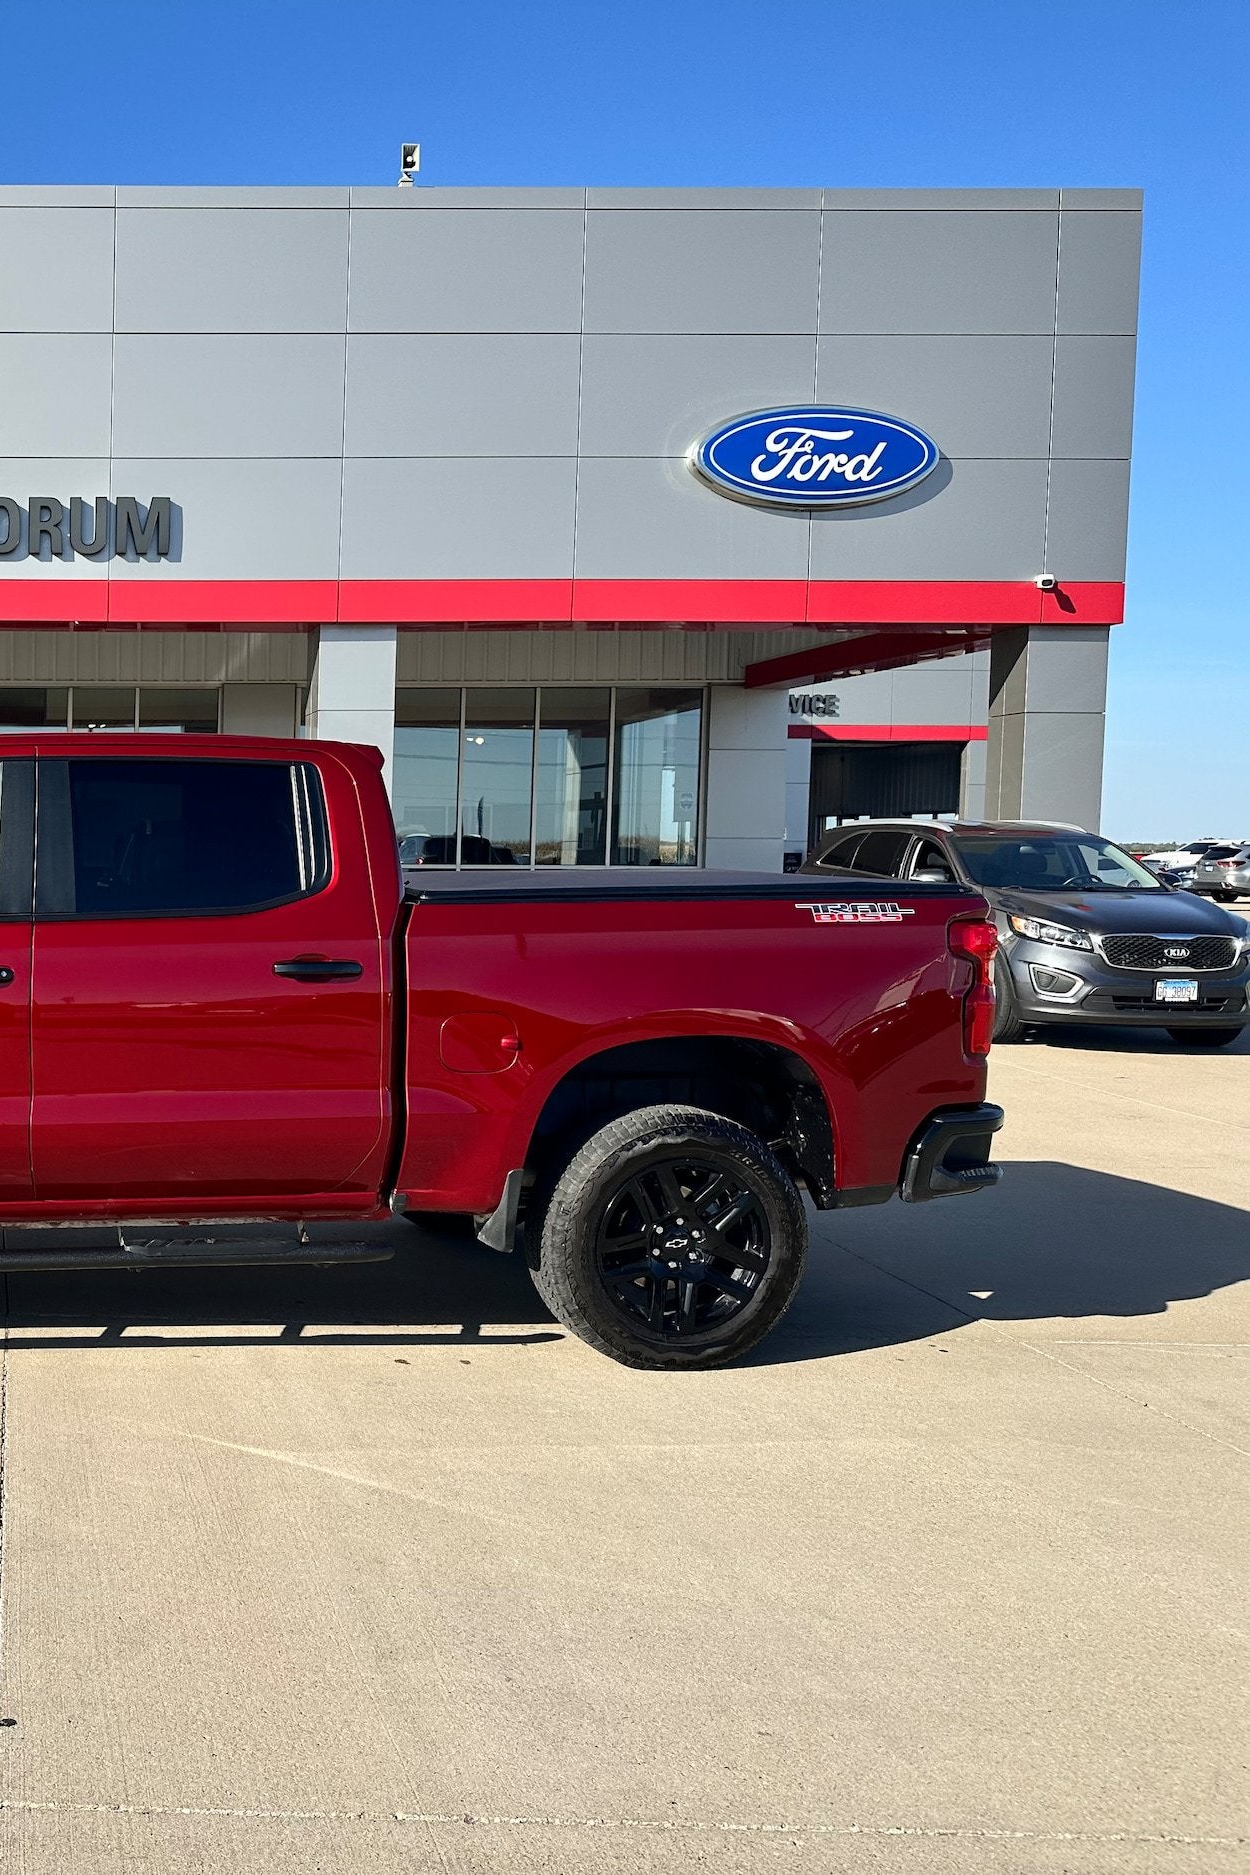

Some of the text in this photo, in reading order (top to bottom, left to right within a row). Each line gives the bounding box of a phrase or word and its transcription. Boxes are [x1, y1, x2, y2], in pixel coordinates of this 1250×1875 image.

[751, 427, 888, 482] Ford
[795, 903, 915, 914] TRAIL
[814, 912, 903, 923] BOSS
